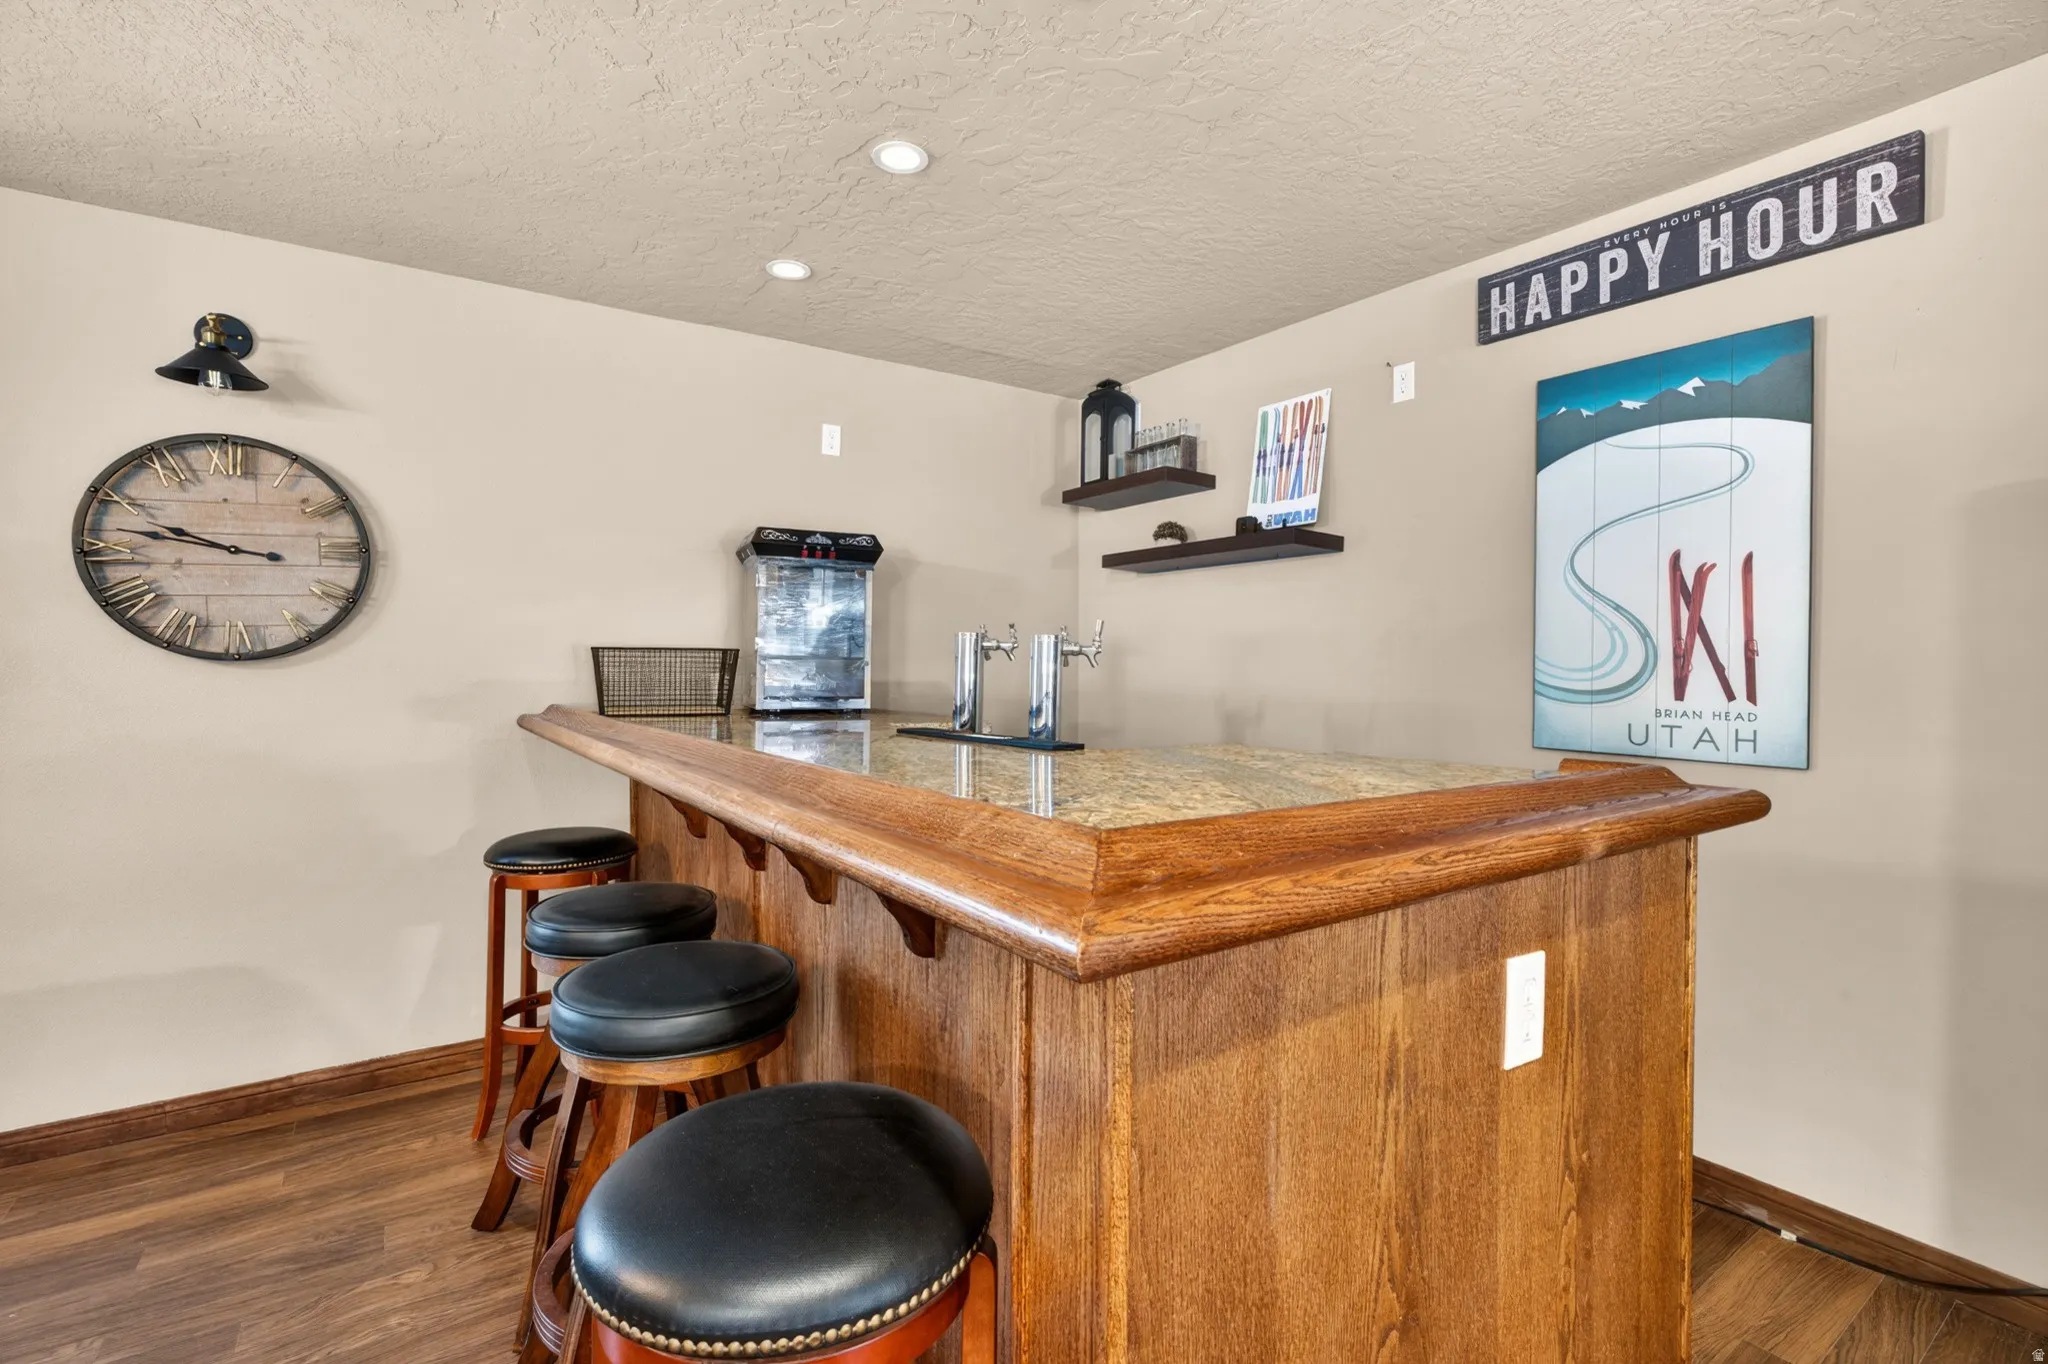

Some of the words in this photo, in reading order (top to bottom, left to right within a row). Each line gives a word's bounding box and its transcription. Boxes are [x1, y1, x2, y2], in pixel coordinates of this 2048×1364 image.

[1603, 226, 1651, 249] EVERY
[1660, 209, 1701, 230] HOUR
[1711, 201, 1727, 213] IS
[1490, 231, 1671, 335] HAPPY
[1698, 161, 1898, 277] HOUR
[141, 446, 187, 488] XI
[202, 440, 243, 476] XII
[1273, 508, 1316, 525] UTAH
[81, 537, 134, 561] IX
[1655, 708, 1703, 720] BRIAN
[1712, 711, 1758, 722] HEAD
[1628, 722, 1758, 754] UTAH
